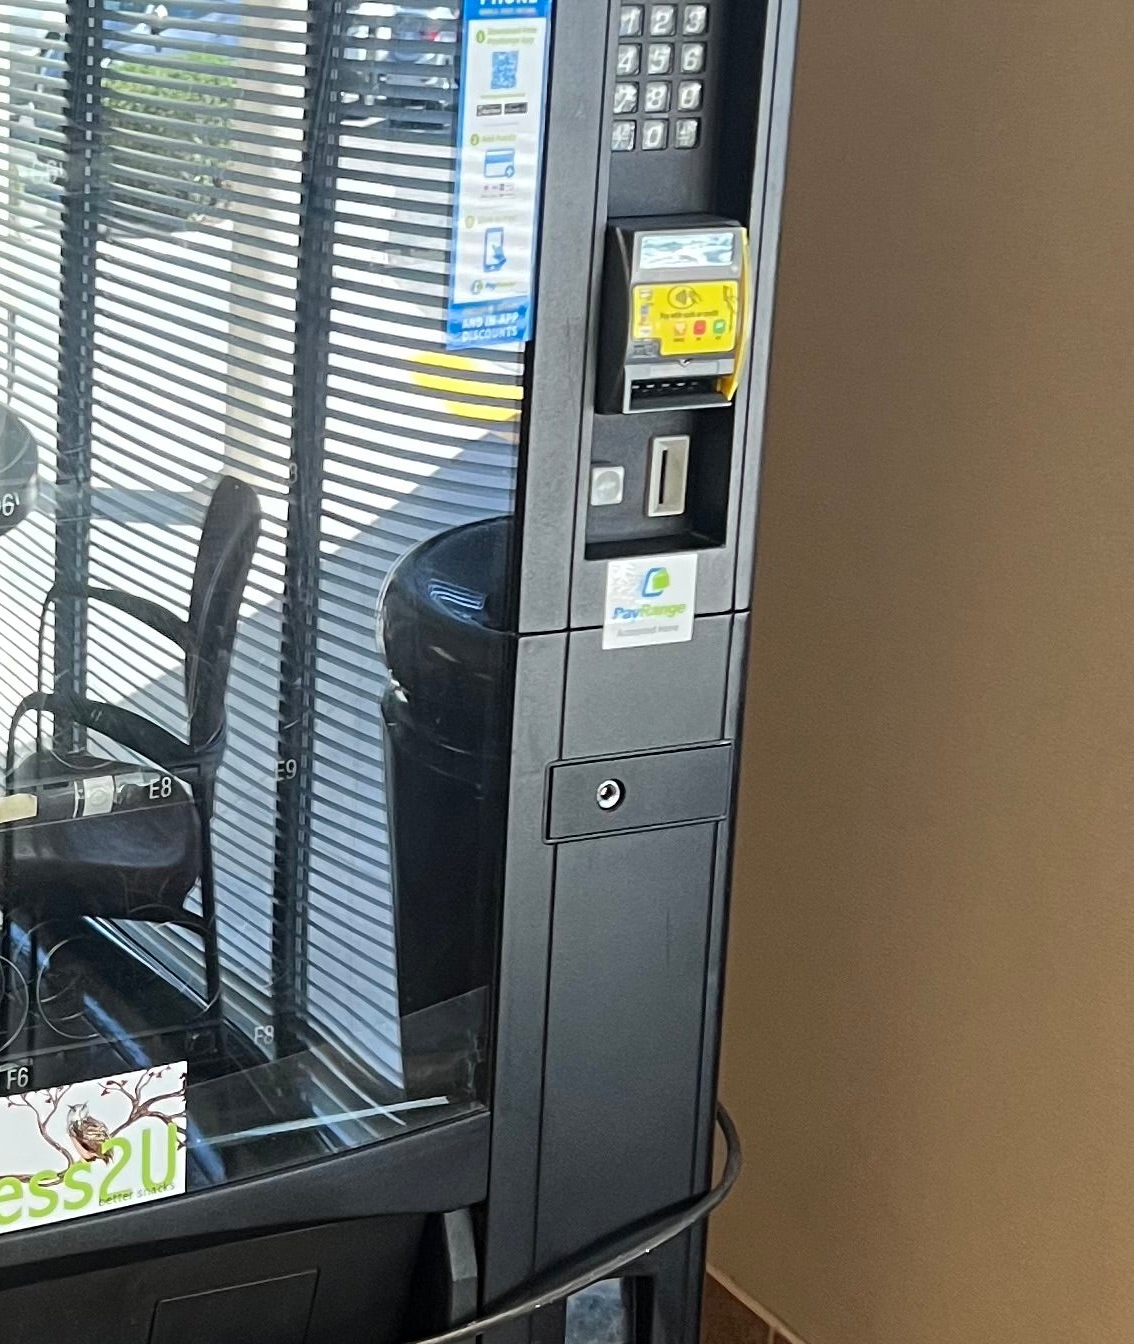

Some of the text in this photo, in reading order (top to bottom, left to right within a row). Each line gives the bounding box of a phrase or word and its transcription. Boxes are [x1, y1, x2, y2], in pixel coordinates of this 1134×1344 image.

[612, 601, 687, 621] PayRange
[275, 758, 298, 782] E9
[148, 776, 172, 800] E8
[6, 1067, 30, 1089] F6
[98, 1181, 177, 1207] better snacks
